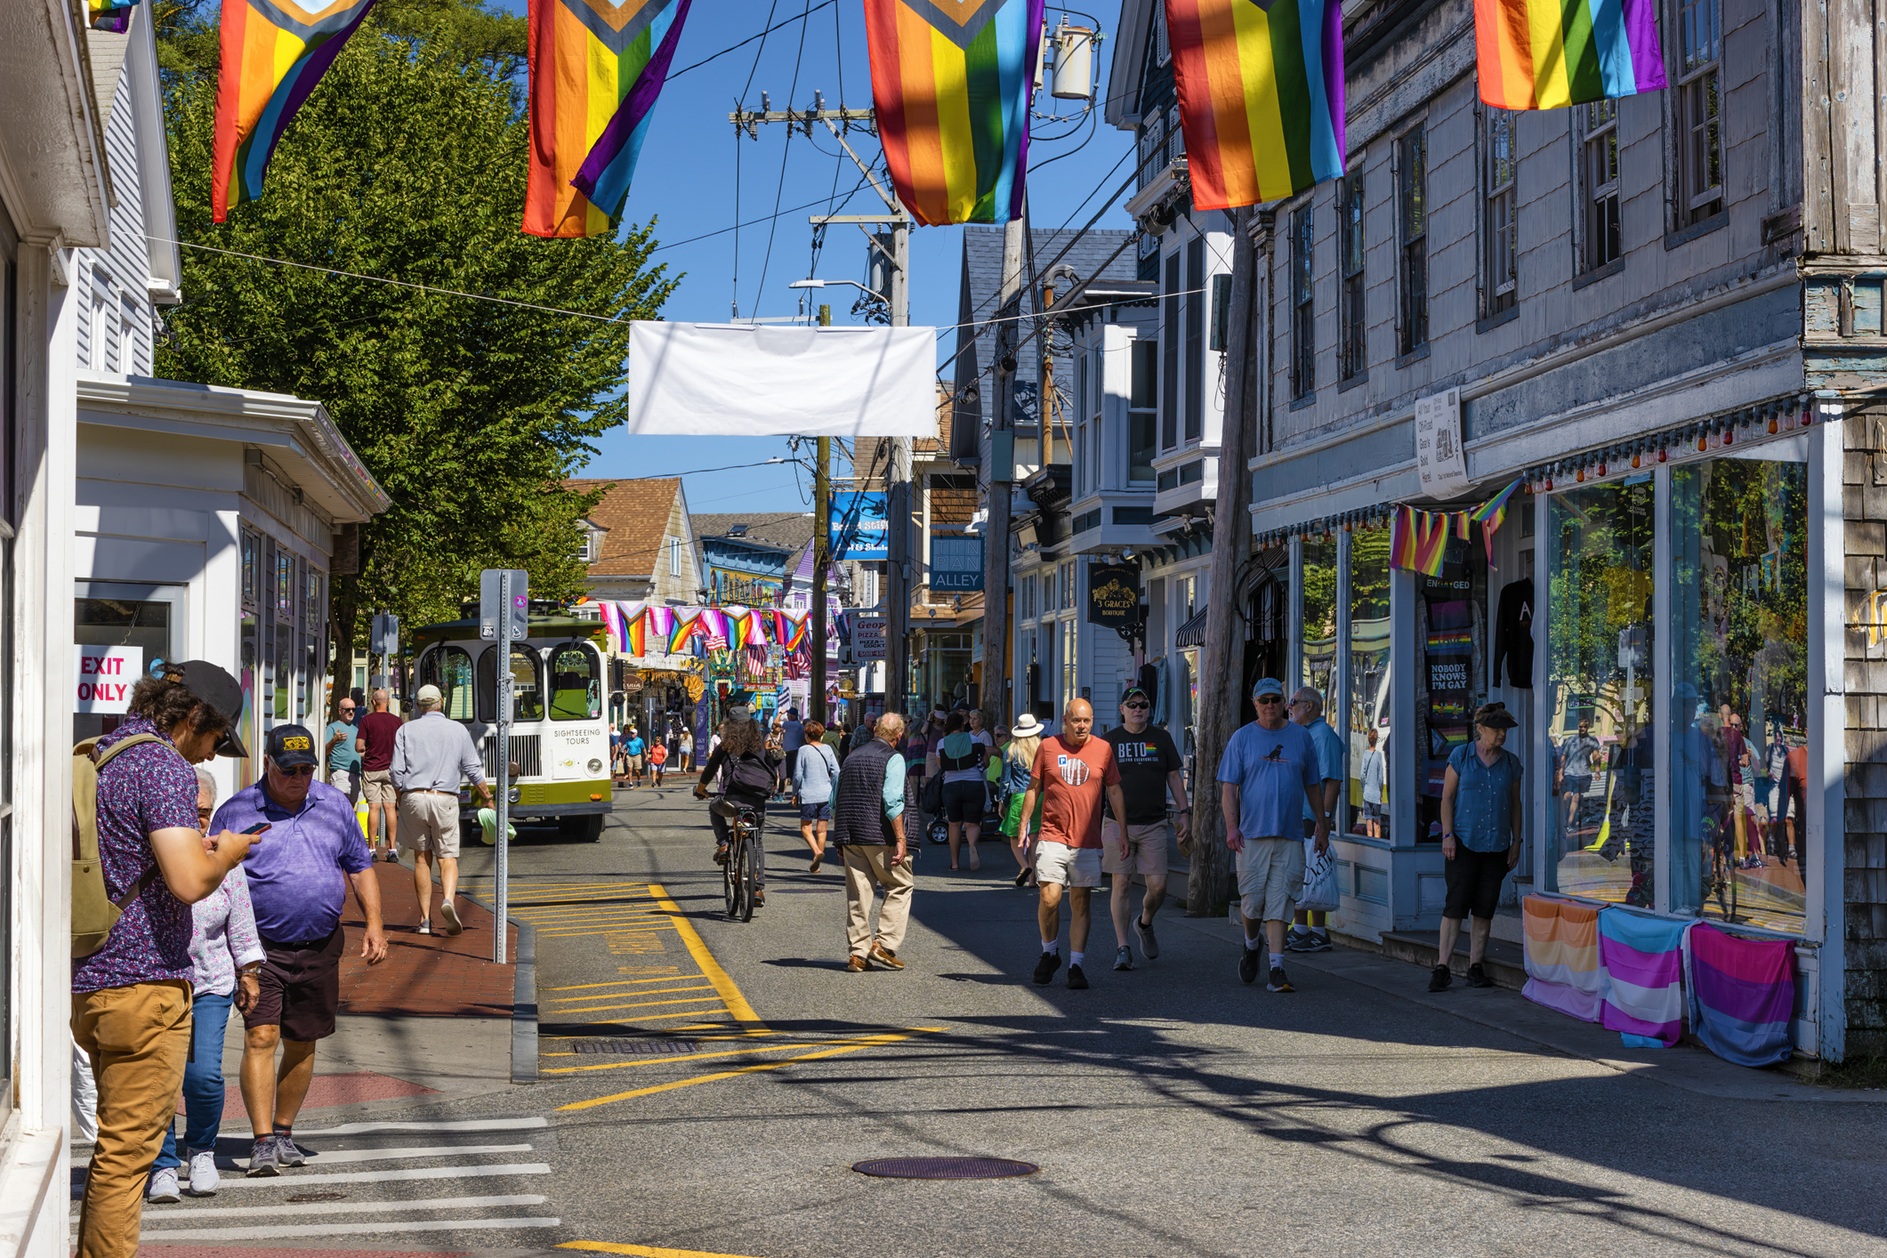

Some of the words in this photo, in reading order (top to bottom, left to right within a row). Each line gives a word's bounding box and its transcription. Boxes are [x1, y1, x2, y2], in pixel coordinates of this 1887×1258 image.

[935, 540, 980, 556] TIN
[936, 556, 980, 570] PAN
[935, 574, 979, 586] ALLEY
[1097, 600, 1103, 608] 3
[1104, 600, 1131, 608] GRACES
[81, 656, 124, 675] EXIT
[1431, 663, 1466, 673] NOBODY
[1432, 672, 1467, 682] KNOWS
[1432, 681, 1446, 690] I'M
[1447, 680, 1467, 690] GAY
[77, 682, 128, 701] ONLY
[553, 729, 601, 738] SIGHTSEEING
[565, 737, 590, 745] TOURS
[1118, 742, 1147, 758] BETO
